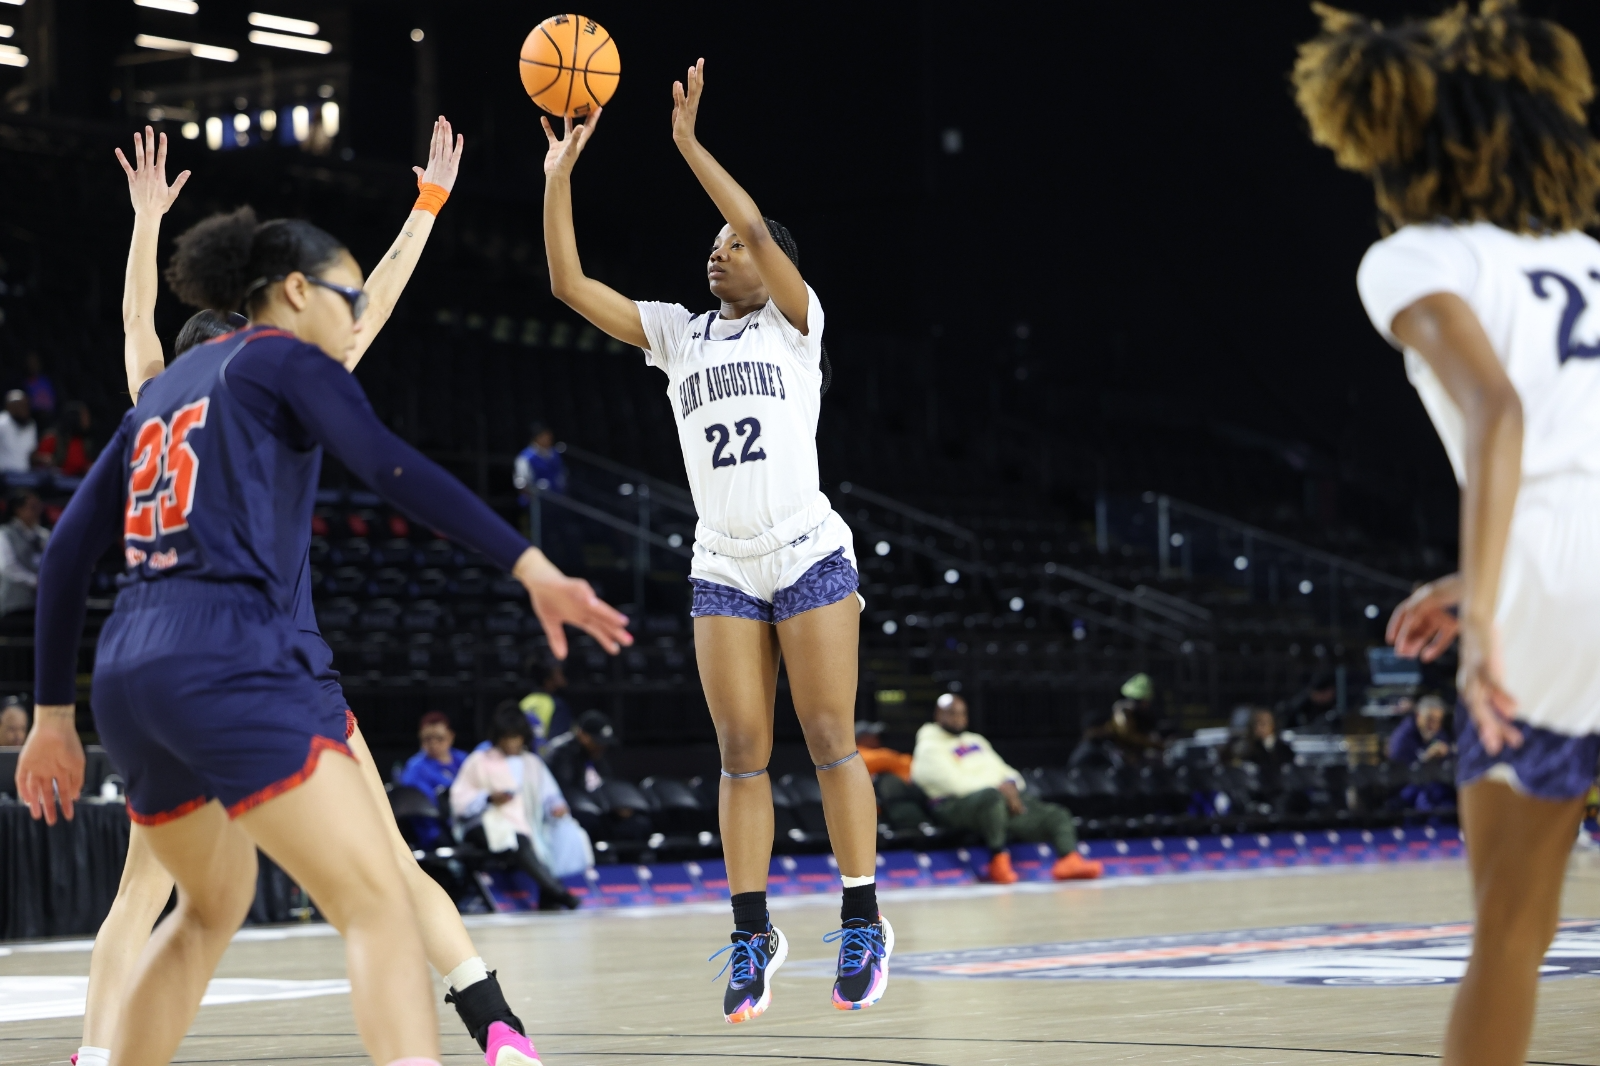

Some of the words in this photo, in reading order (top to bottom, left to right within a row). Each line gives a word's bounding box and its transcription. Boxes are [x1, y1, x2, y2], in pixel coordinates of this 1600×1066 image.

[1521, 268, 1600, 367] 2
[679, 371, 703, 420] SAINT
[706, 361, 786, 402] AUGUSTINE'S
[124, 396, 210, 542] 25
[704, 416, 767, 470] 22
